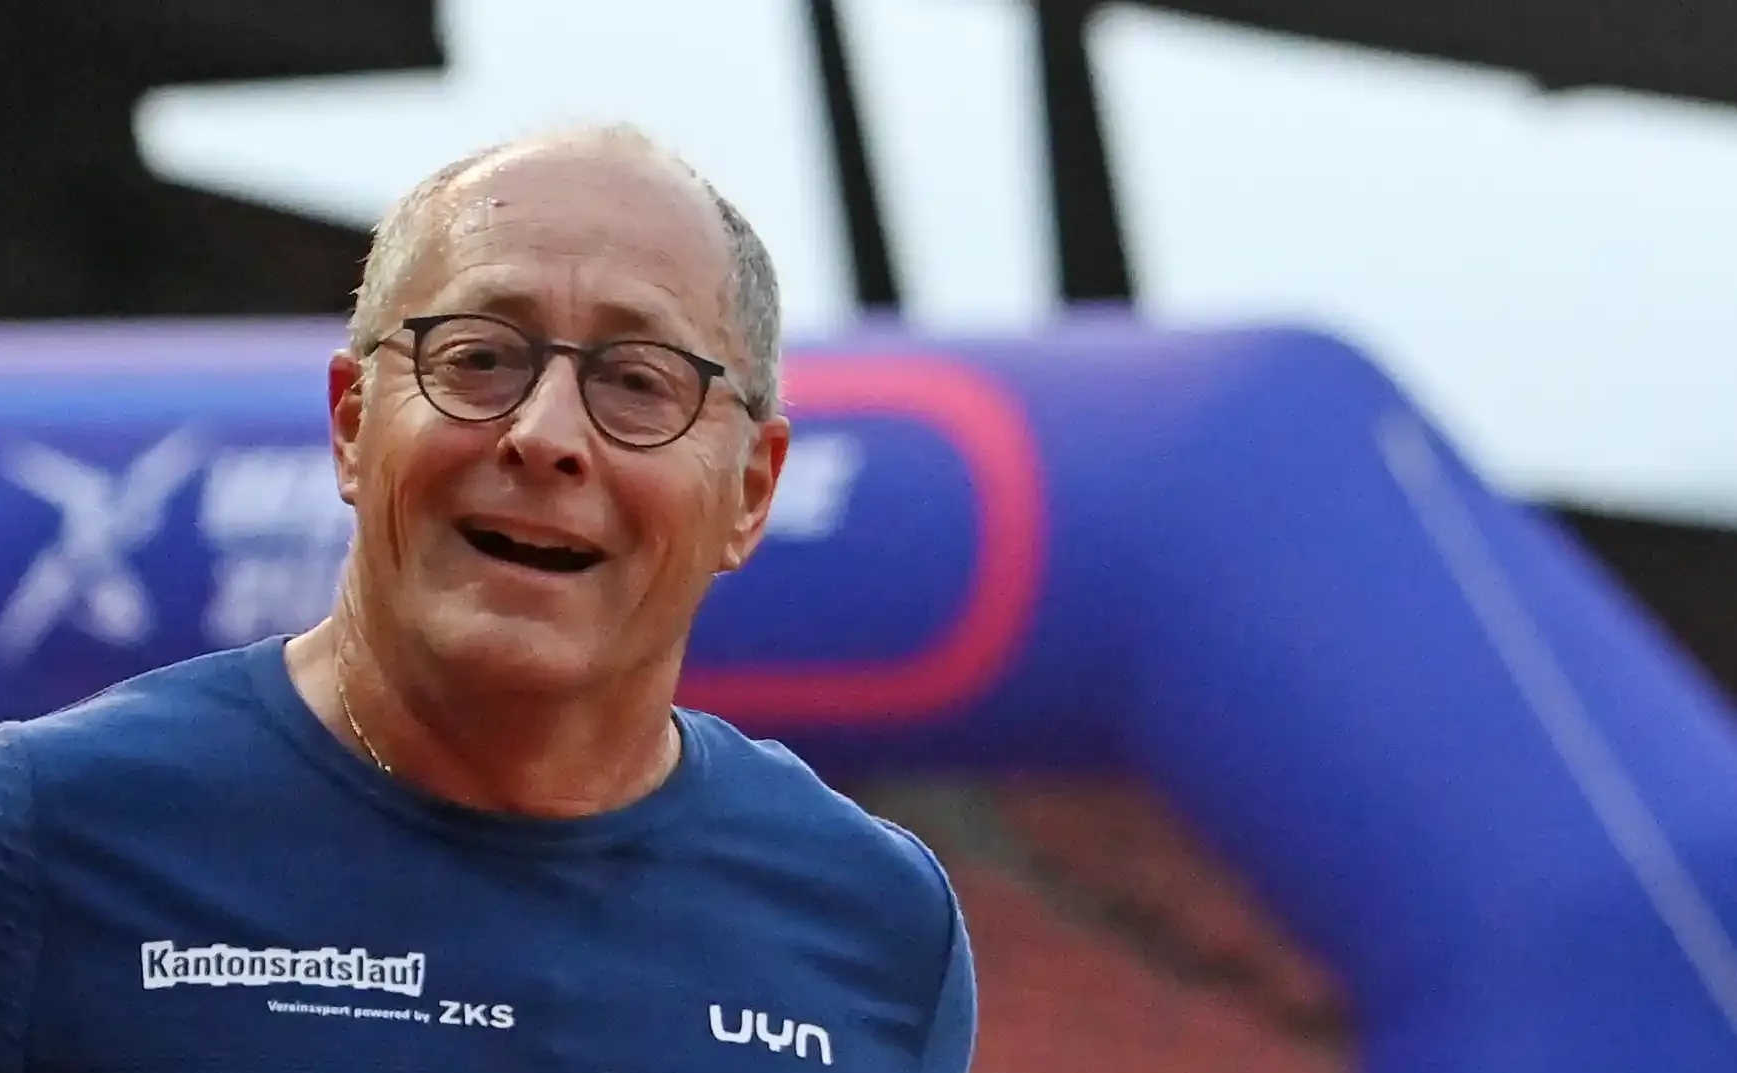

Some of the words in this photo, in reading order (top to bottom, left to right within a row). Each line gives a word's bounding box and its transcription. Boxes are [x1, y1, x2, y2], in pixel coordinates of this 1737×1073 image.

[145, 944, 423, 991] Kantonsratslauf
[354, 1007, 410, 1021] powered
[413, 1010, 431, 1024] by
[438, 1000, 515, 1028] ZKS
